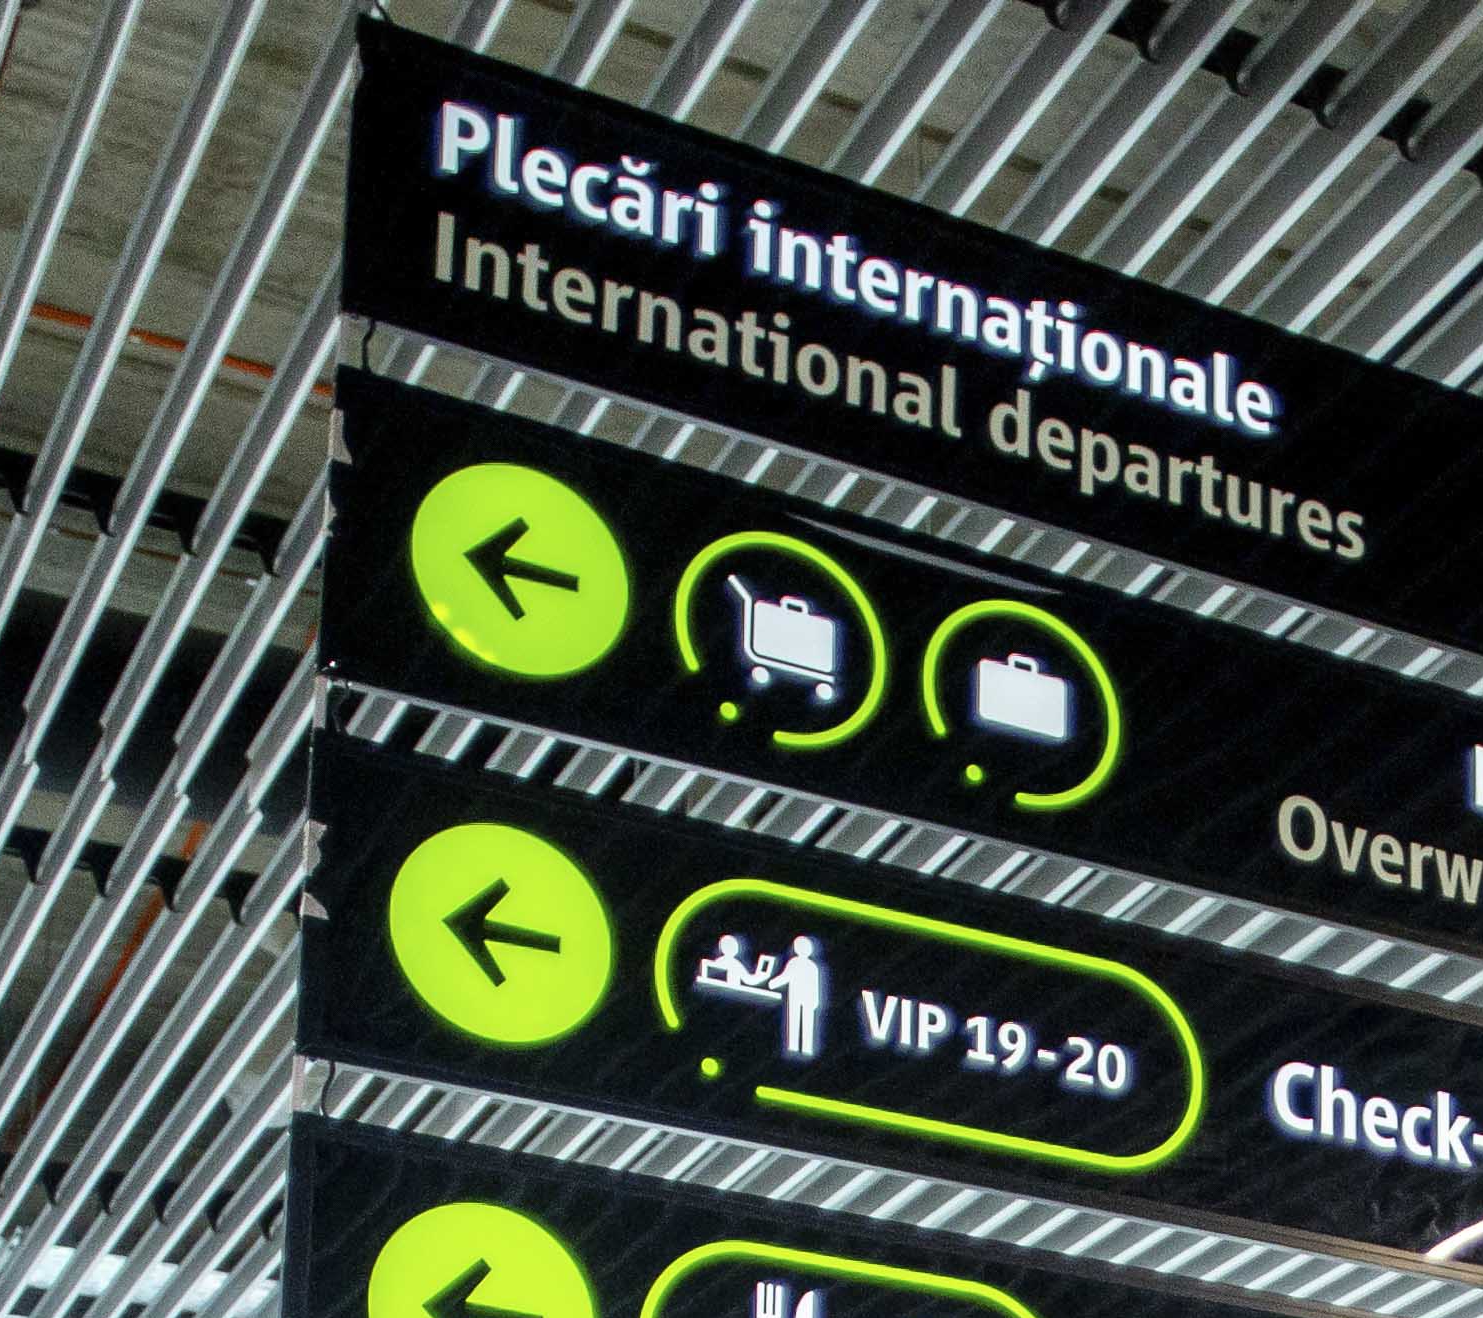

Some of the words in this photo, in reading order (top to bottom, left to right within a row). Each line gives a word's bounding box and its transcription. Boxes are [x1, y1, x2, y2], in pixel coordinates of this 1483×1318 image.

[433, 213, 961, 439] International
[989, 389, 1366, 559] departures
[438, 99, 721, 256] Plecări
[749, 200, 1278, 437] internaționale
[862, 989, 947, 1050] VIP
